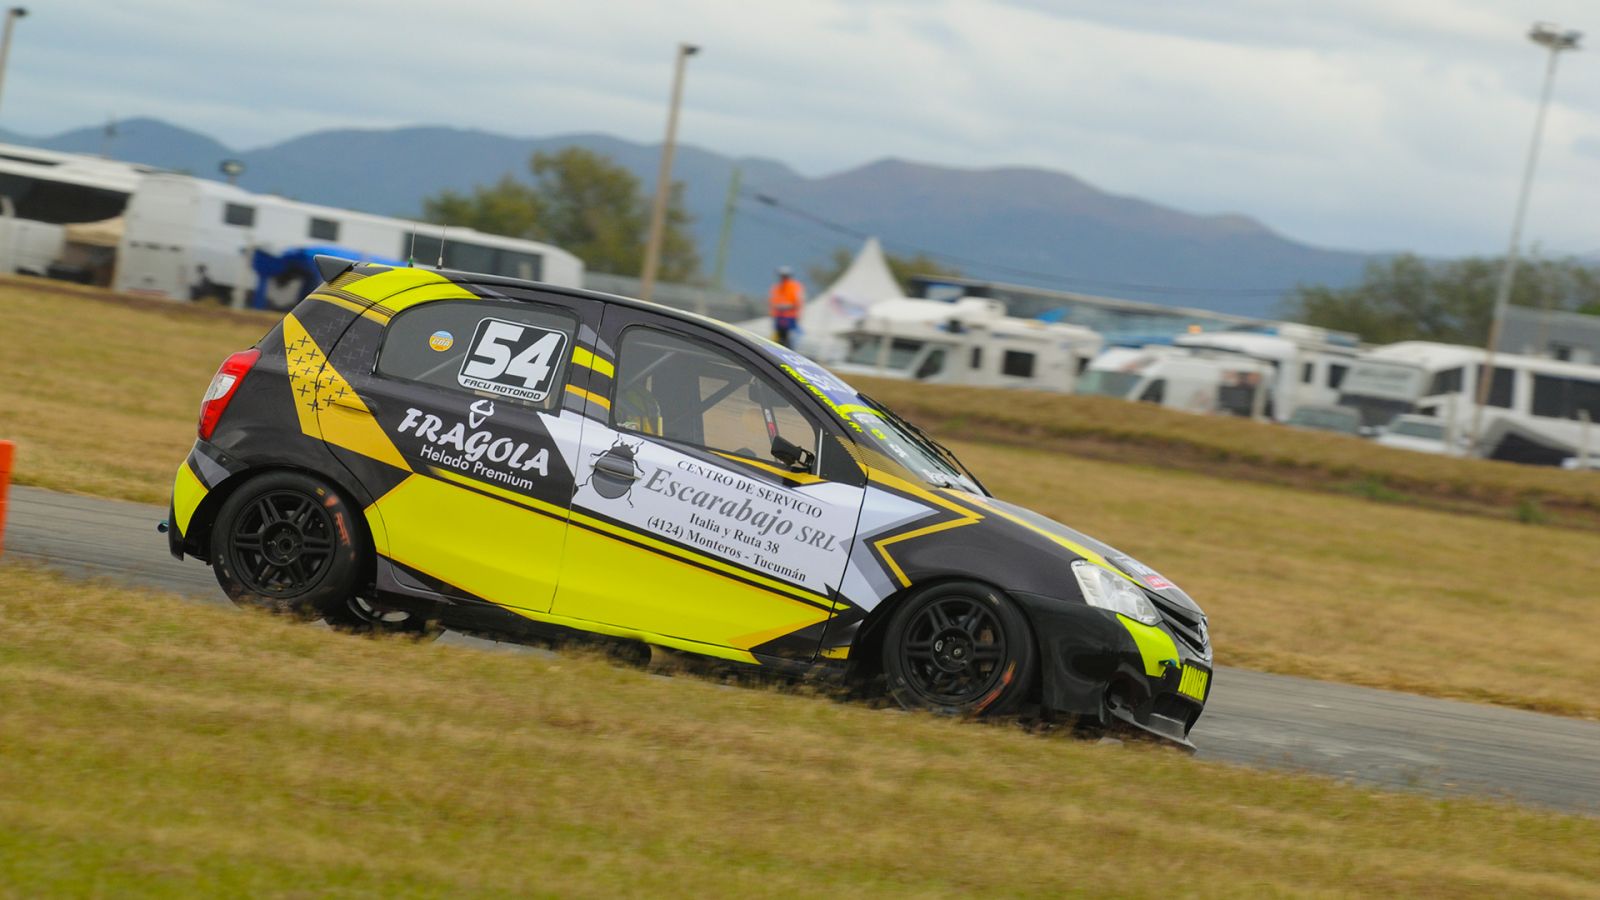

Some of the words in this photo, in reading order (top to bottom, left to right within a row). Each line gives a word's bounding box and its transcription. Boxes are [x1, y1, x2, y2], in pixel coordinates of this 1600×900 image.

[463, 320, 562, 390] 54
[463, 378, 491, 390] FACU
[492, 383, 541, 400] ROTONDO
[397, 407, 550, 477] FRAGOLA
[420, 445, 470, 470] Helado
[473, 461, 534, 490] Premium
[643, 466, 794, 536] Escarabajo
[794, 525, 837, 553] SRL
[677, 460, 734, 486] CENTRO
[735, 481, 755, 494] DE
[756, 487, 823, 519] SERVICIO
[647, 515, 685, 539] (4124)
[686, 530, 741, 560] Monteros
[752, 552, 807, 583] Tucumán
[689, 513, 720, 533] Italia
[721, 526, 731, 539] y
[733, 528, 762, 549] Ruta
[764, 540, 780, 555] 38
